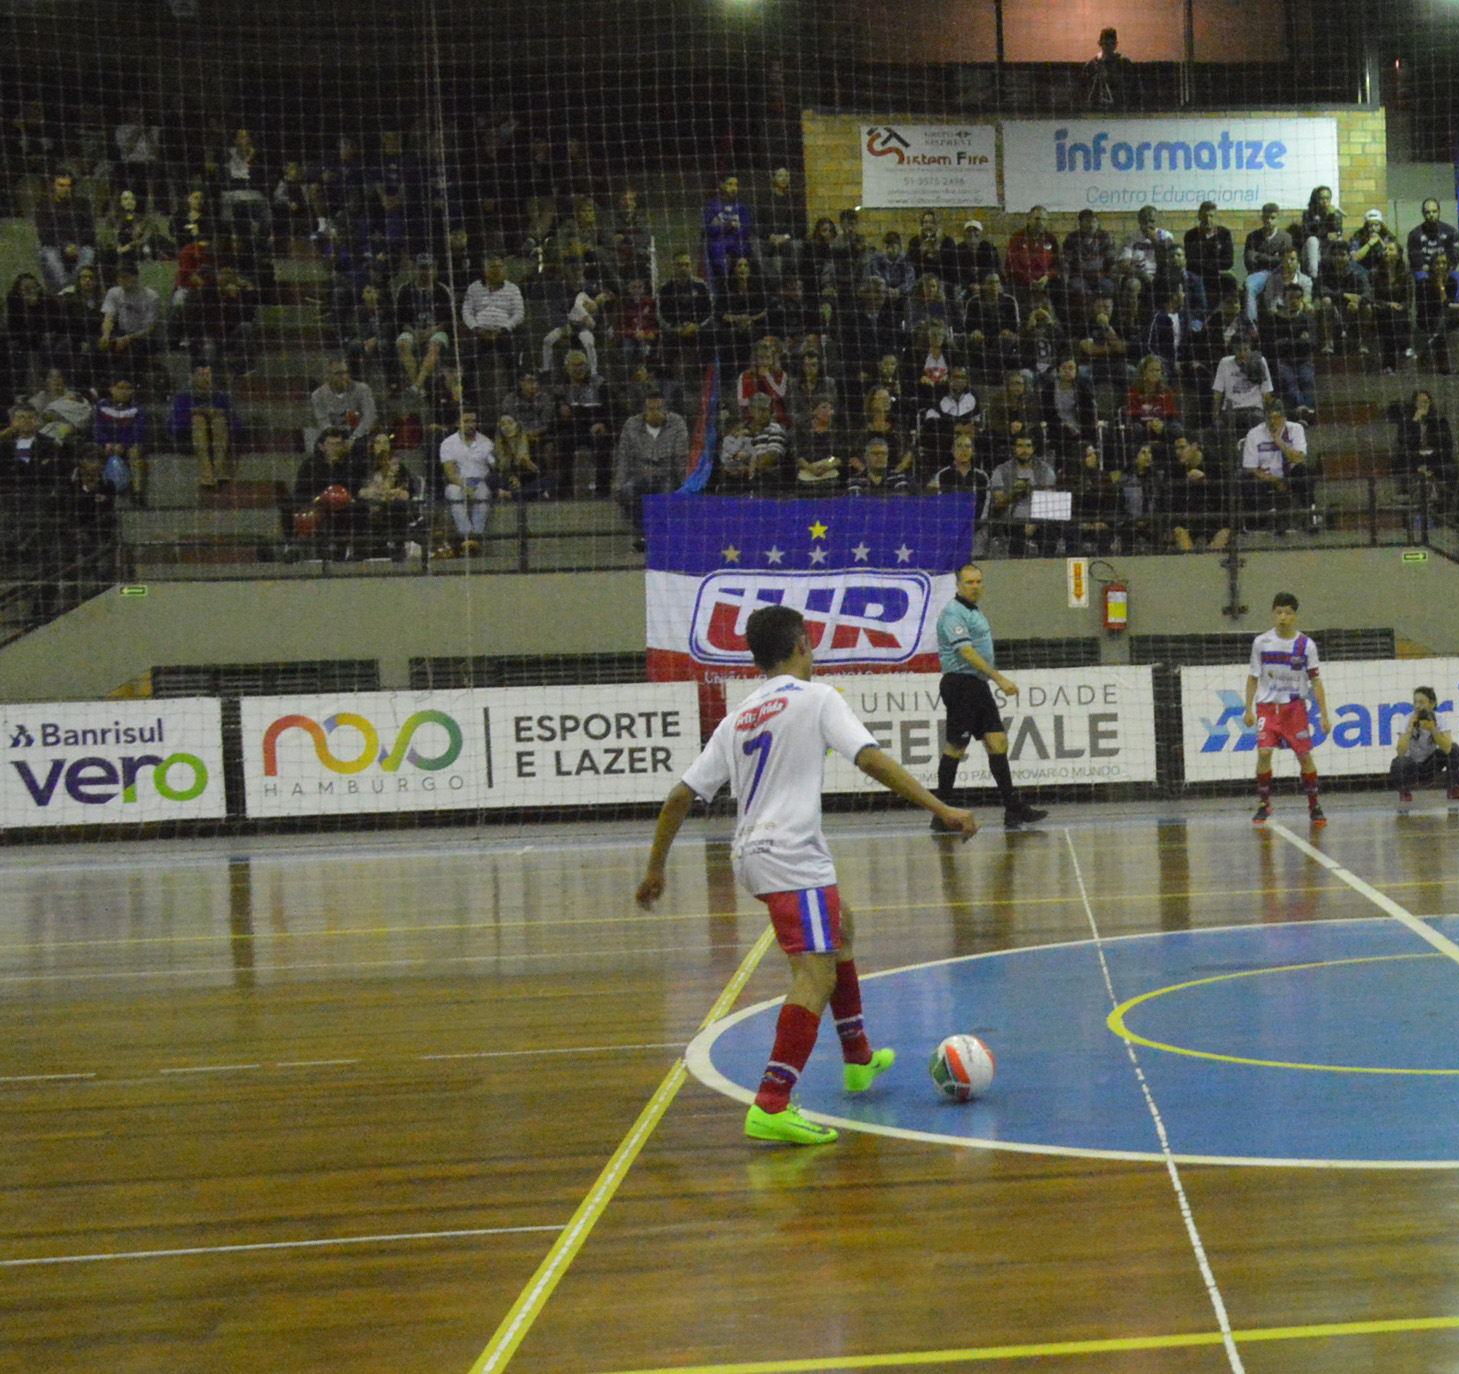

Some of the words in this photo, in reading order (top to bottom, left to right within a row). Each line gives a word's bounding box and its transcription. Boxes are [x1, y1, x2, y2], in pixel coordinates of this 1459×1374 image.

[956, 151, 989, 165] Fire
[1055, 129, 1288, 173] informatize
[1086, 186, 1147, 205] Centro
[1151, 184, 1260, 204] Educacional
[860, 683, 1118, 713] UNIVSIDADE
[41, 718, 165, 748] Banrisul
[514, 711, 682, 743] ESPORTE
[516, 753, 536, 778] E
[555, 747, 673, 778] LAZER
[742, 730, 773, 815] 7
[1072, 765, 1121, 778] MUNDO
[10, 752, 209, 807] vero
[263, 774, 466, 798] HAMBURGO
